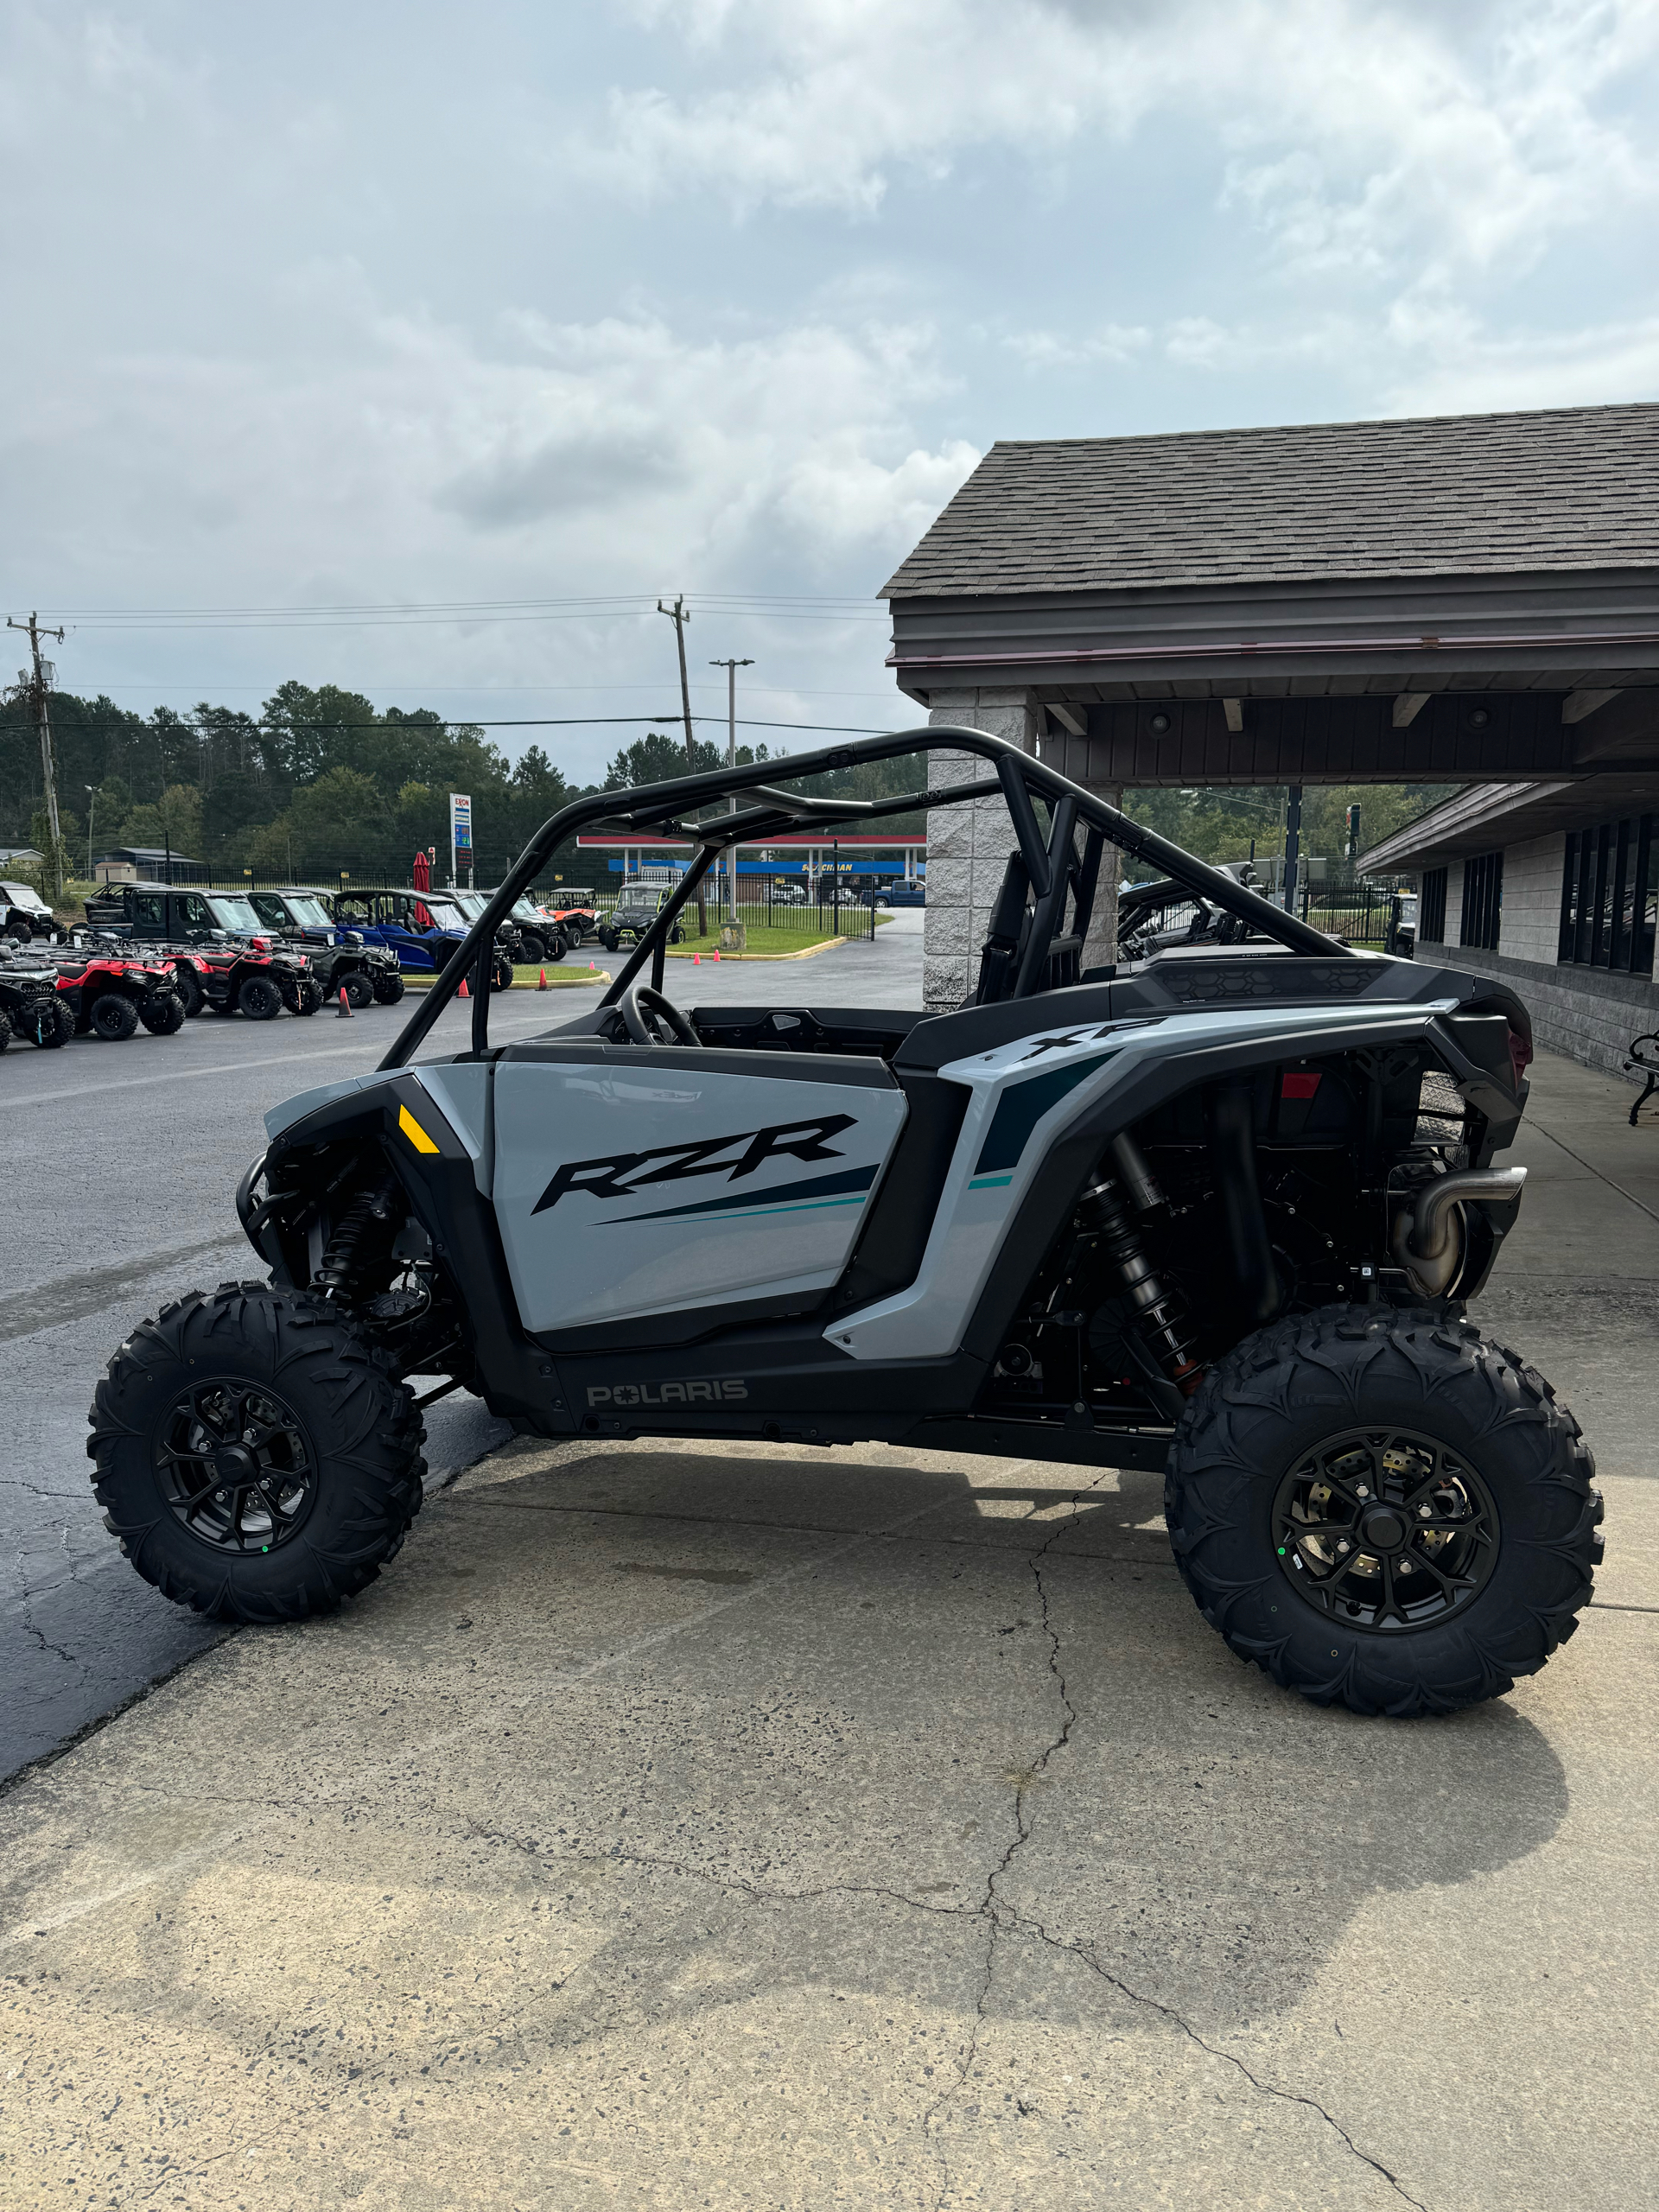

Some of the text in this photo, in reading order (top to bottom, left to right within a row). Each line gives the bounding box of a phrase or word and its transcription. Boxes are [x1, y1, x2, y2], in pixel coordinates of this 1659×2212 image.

[455, 798, 469, 808] EXXON
[802, 863, 853, 872] SOCHMAN
[530, 1113, 859, 1216] RZR
[586, 1379, 749, 1407] POLARIS
